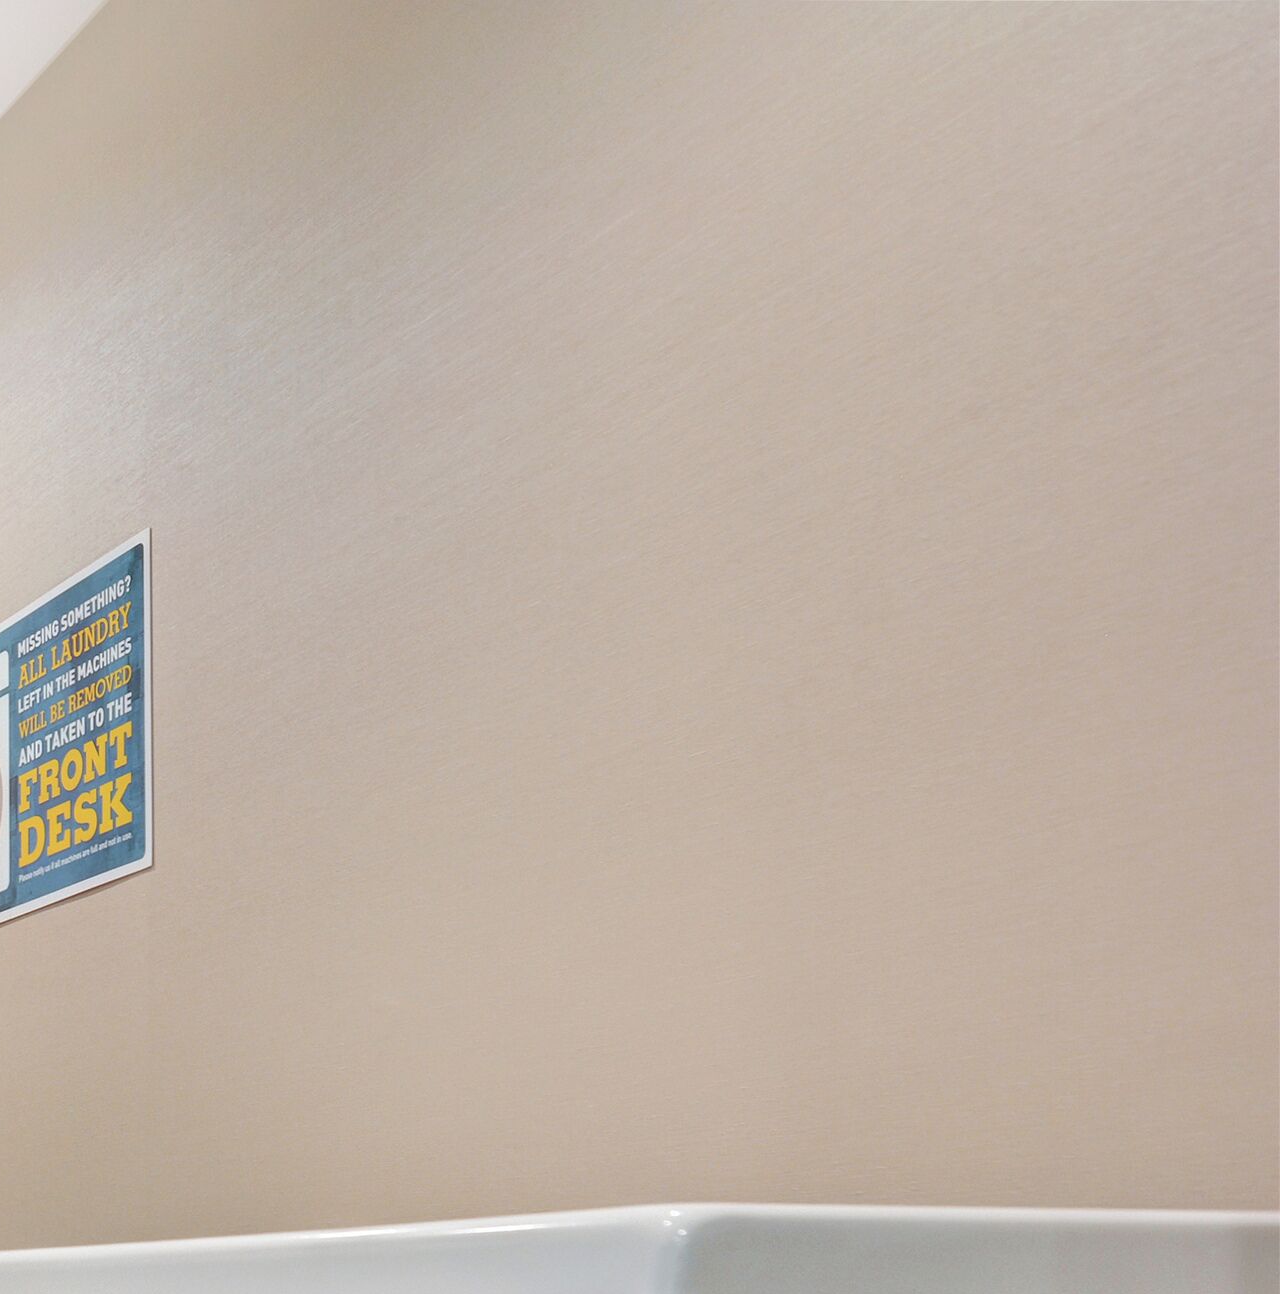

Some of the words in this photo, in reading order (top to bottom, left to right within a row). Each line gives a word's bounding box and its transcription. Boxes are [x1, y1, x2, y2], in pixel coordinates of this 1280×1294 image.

[17, 619, 59, 658] MISSING
[61, 574, 132, 632] SOMETHING?
[18, 654, 47, 689] ALL
[51, 601, 132, 670] LAUNDRY
[18, 688, 42, 714] LEFT
[43, 680, 54, 700] IN
[55, 668, 76, 692] THE
[77, 637, 132, 680] MACHINES
[19, 710, 47, 739] WILL
[50, 700, 65, 724] BE
[68, 664, 132, 714] REMOVED
[18, 739, 43, 767] AND
[45, 717, 85, 753] TAKEN
[88, 707, 105, 731] TO
[107, 692, 132, 722] THE
[18, 720, 133, 814] FRONT
[18, 772, 133, 868] DESK
[98, 840, 107, 851] and
